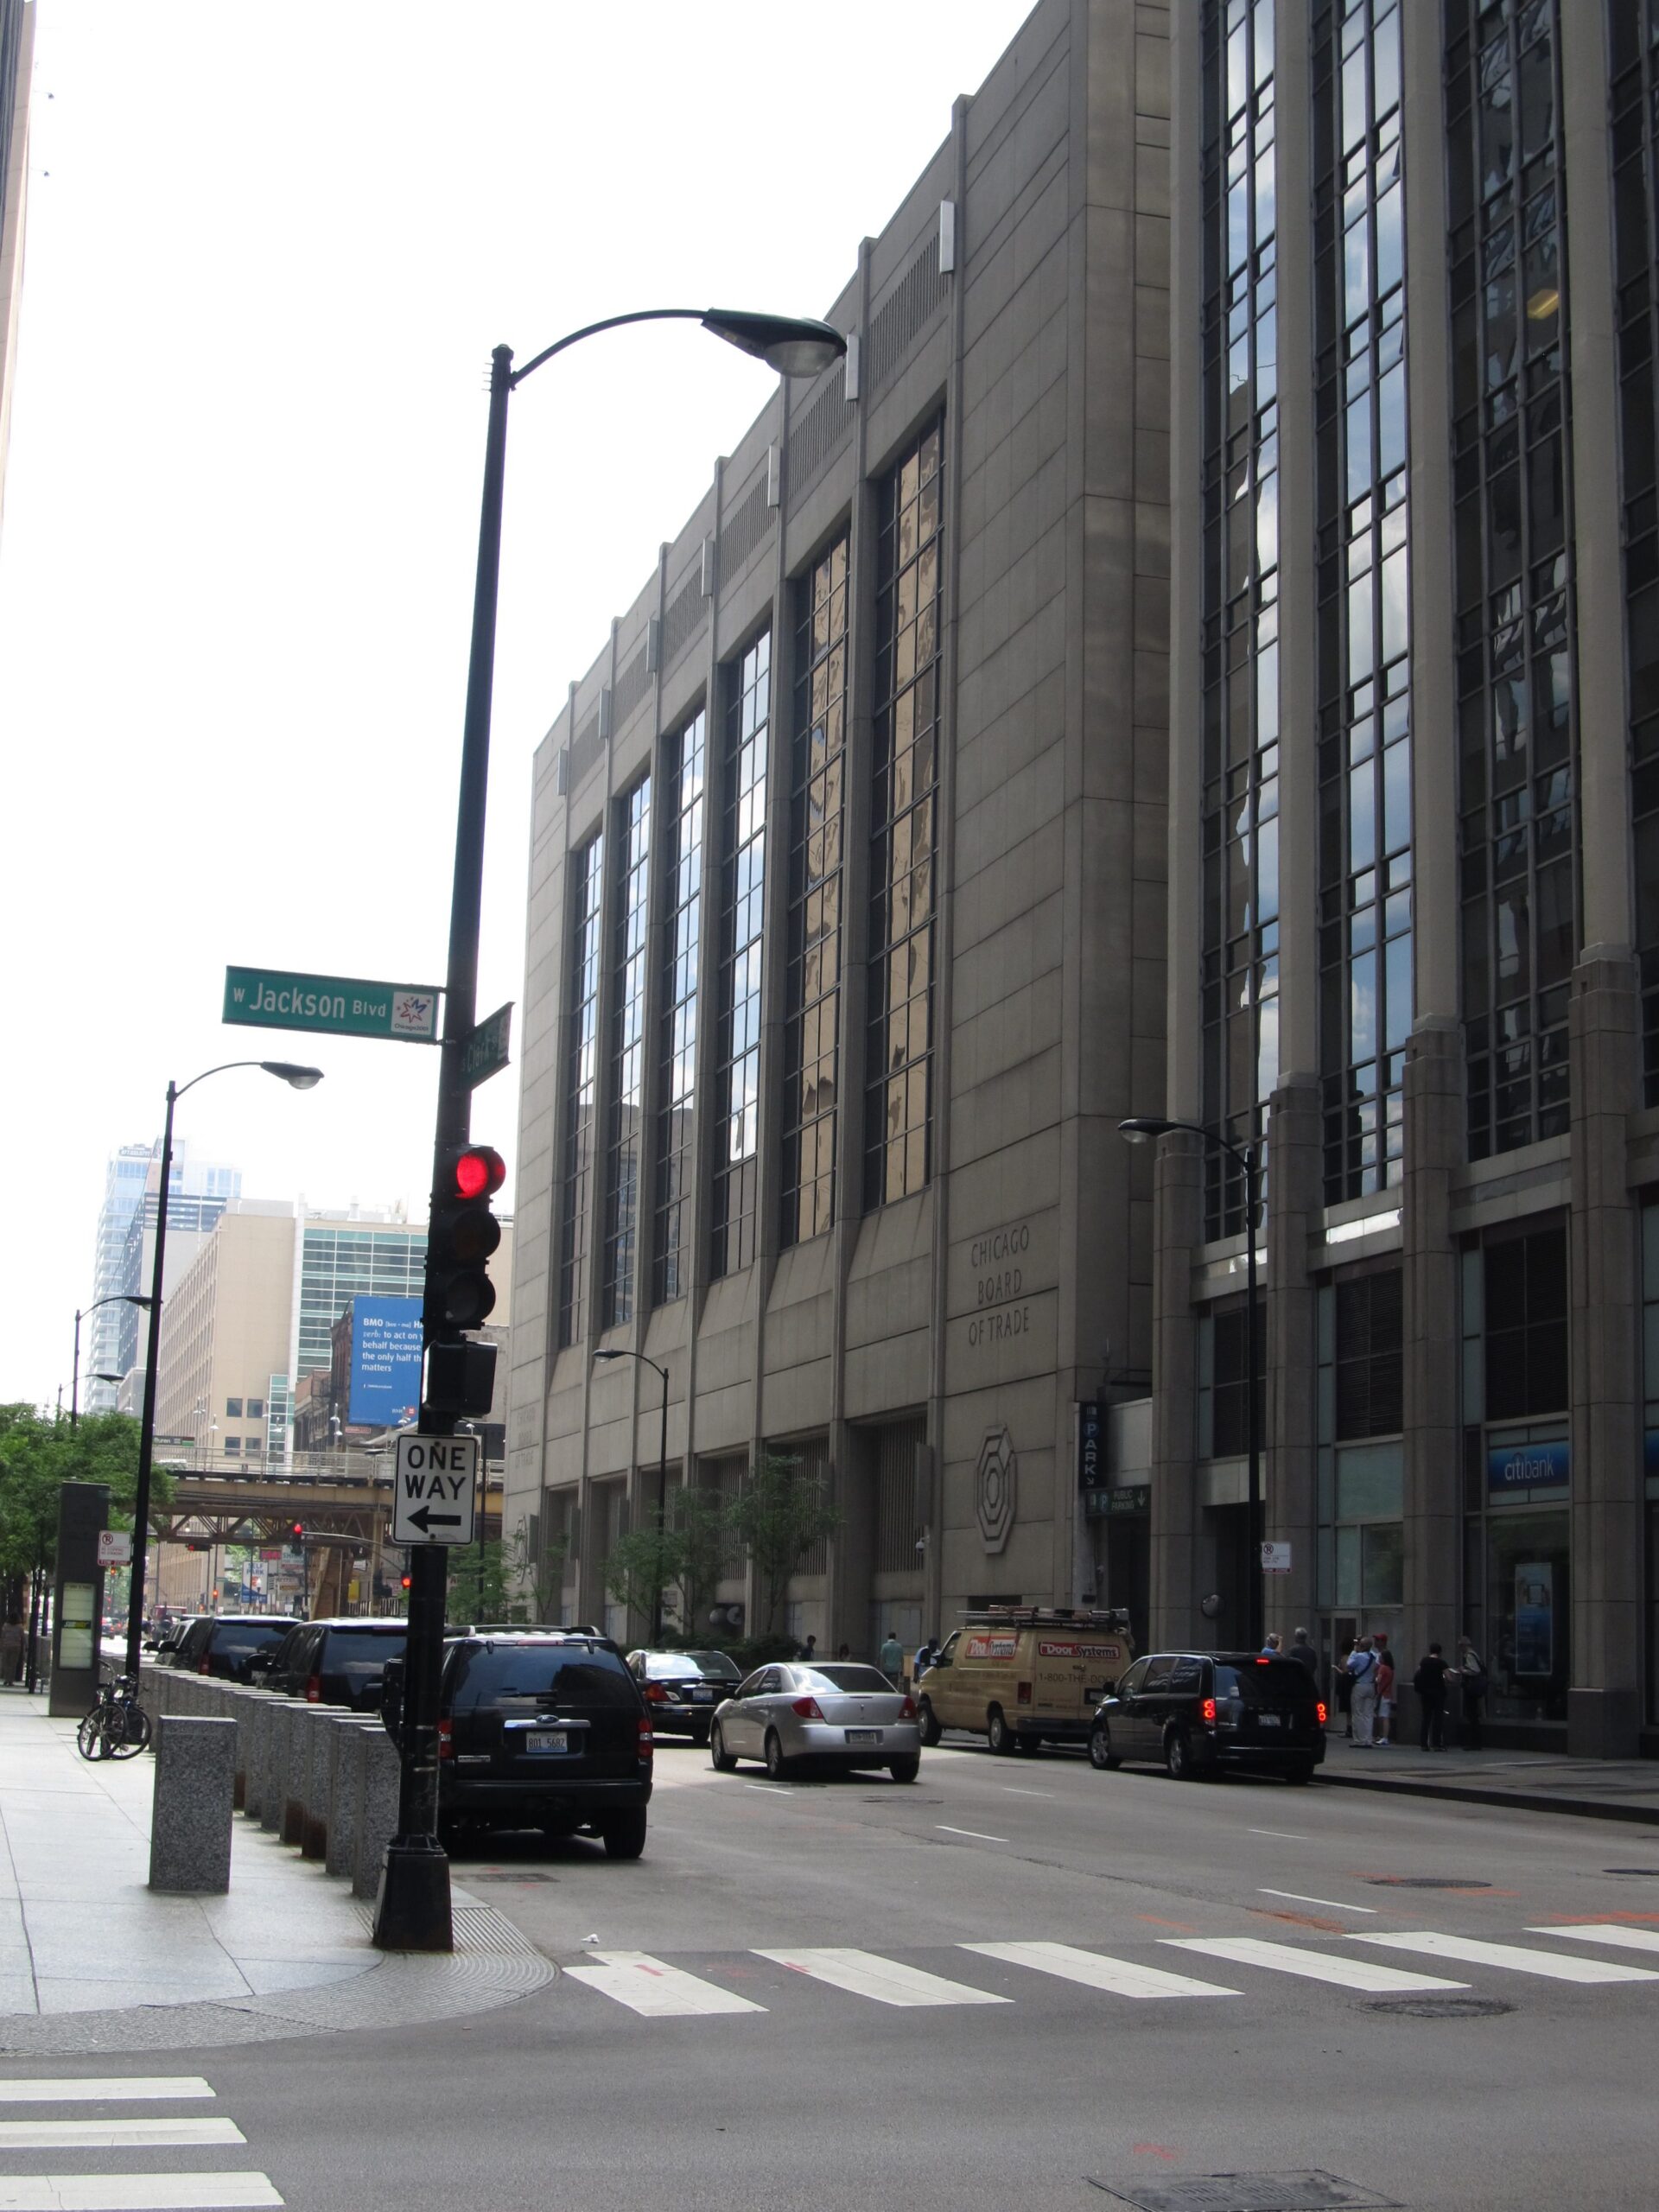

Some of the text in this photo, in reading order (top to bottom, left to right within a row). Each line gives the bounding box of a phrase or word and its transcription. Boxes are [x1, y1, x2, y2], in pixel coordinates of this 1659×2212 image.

[233, 982, 386, 1020] W Jackson Blvd
[970, 1224, 1030, 1268] CHICAGO
[977, 1268, 1022, 1306] BOARD
[363, 1318, 384, 1327] BMO
[968, 1306, 1030, 1347] OF TRADE
[362, 1340, 421, 1351] behalf because
[362, 1351, 376, 1360] the
[377, 1352, 395, 1363] only
[396, 1352, 411, 1362] half
[361, 1363, 392, 1372] matters
[407, 1445, 467, 1471] ONE
[1084, 1423, 1097, 1475] PARK
[1504, 1452, 1554, 1481] citibank
[404, 1474, 467, 1501] WAY
[1113, 1490, 1134, 1501] PUBLIC
[1046, 1644, 1117, 1658] Door Systems
[528, 1738, 543, 1749] 801
